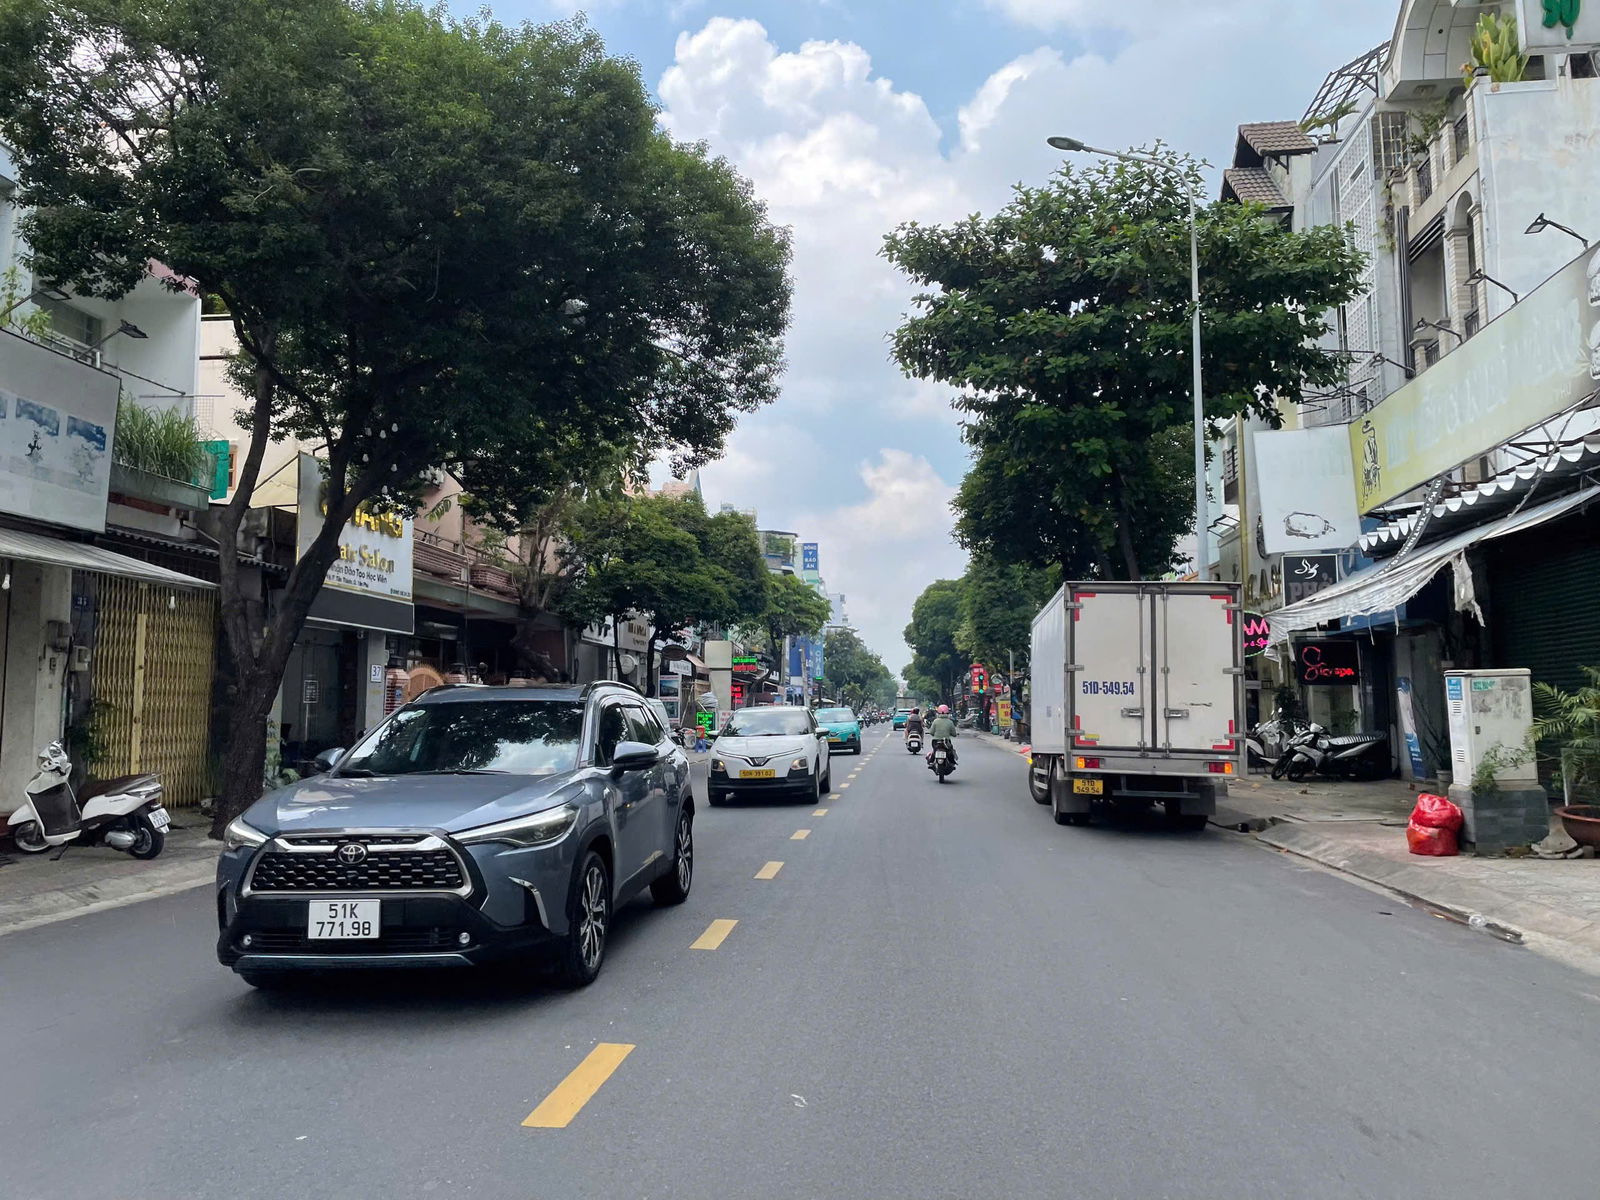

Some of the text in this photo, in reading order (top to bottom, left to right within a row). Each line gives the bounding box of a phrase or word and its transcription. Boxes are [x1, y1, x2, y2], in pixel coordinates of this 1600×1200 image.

[359, 544, 394, 573] Salon
[366, 572, 377, 583] Học
[373, 665, 381, 677] 37
[1082, 680, 1135, 695] 51D-549.54
[1081, 779, 1095, 787] 51D
[329, 903, 358, 919] 51K
[316, 921, 371, 937] 771.98
